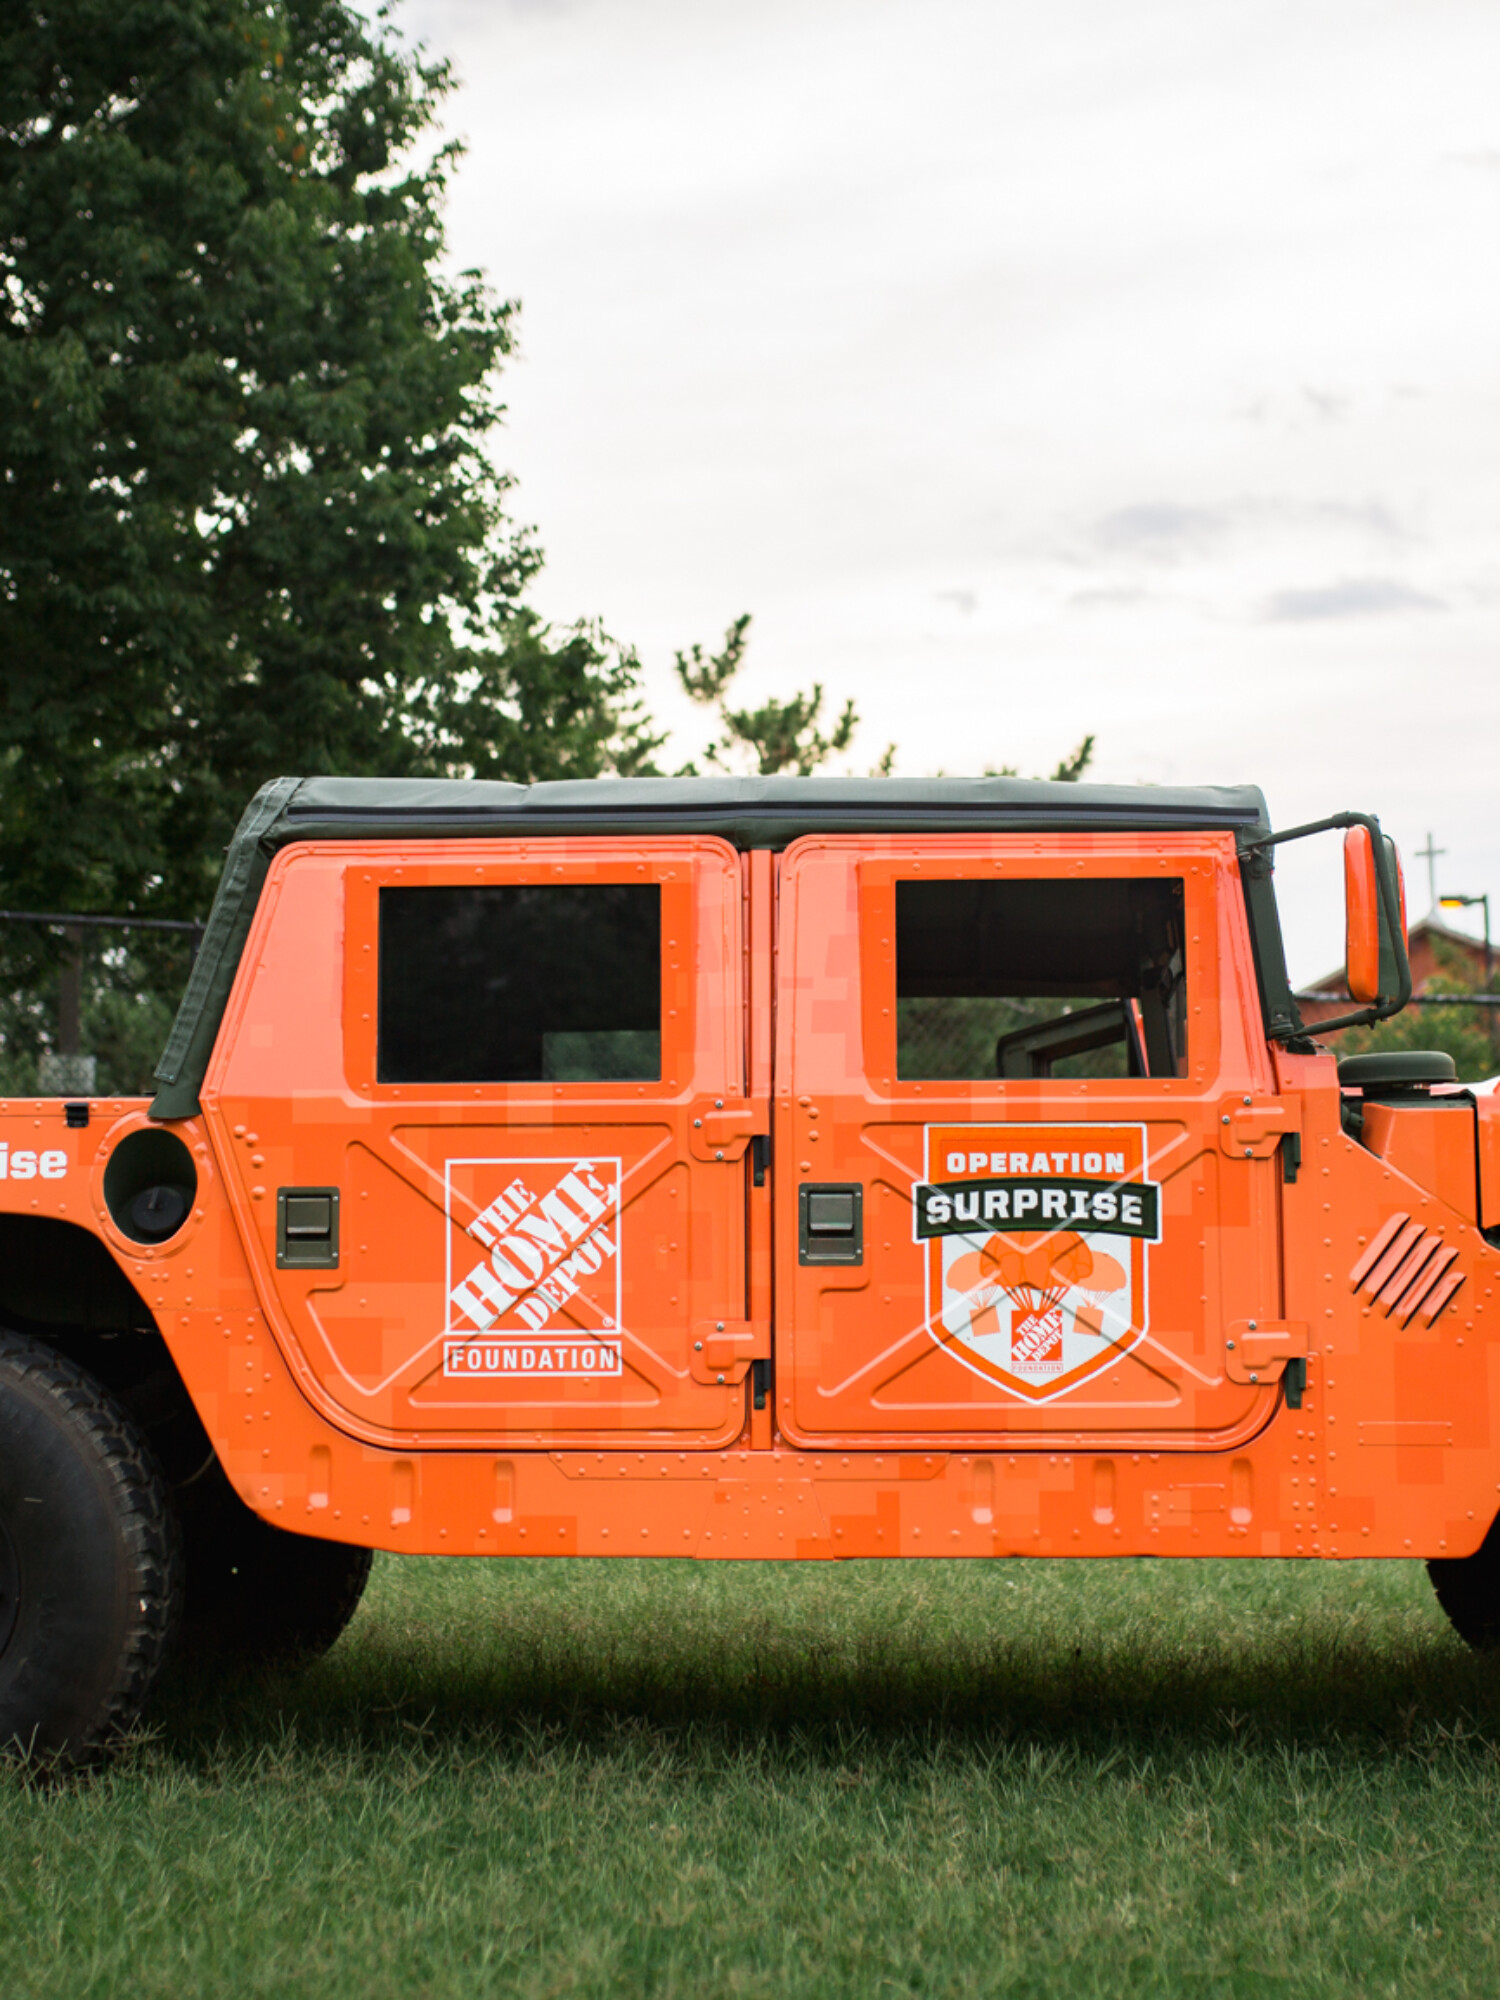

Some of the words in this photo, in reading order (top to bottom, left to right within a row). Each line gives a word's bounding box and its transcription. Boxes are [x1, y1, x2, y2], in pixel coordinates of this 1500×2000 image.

[946, 1152, 1125, 1173] OPERATION
[466, 1178, 537, 1247] THE
[926, 1189, 1143, 1225] SURPRISE
[450, 1161, 617, 1330] HOME
[514, 1223, 617, 1330] DEPOT
[1011, 1310, 1063, 1362] HOME
[1031, 1327, 1063, 1362] DEPOT
[452, 1348, 614, 1370] FOUNDATION
